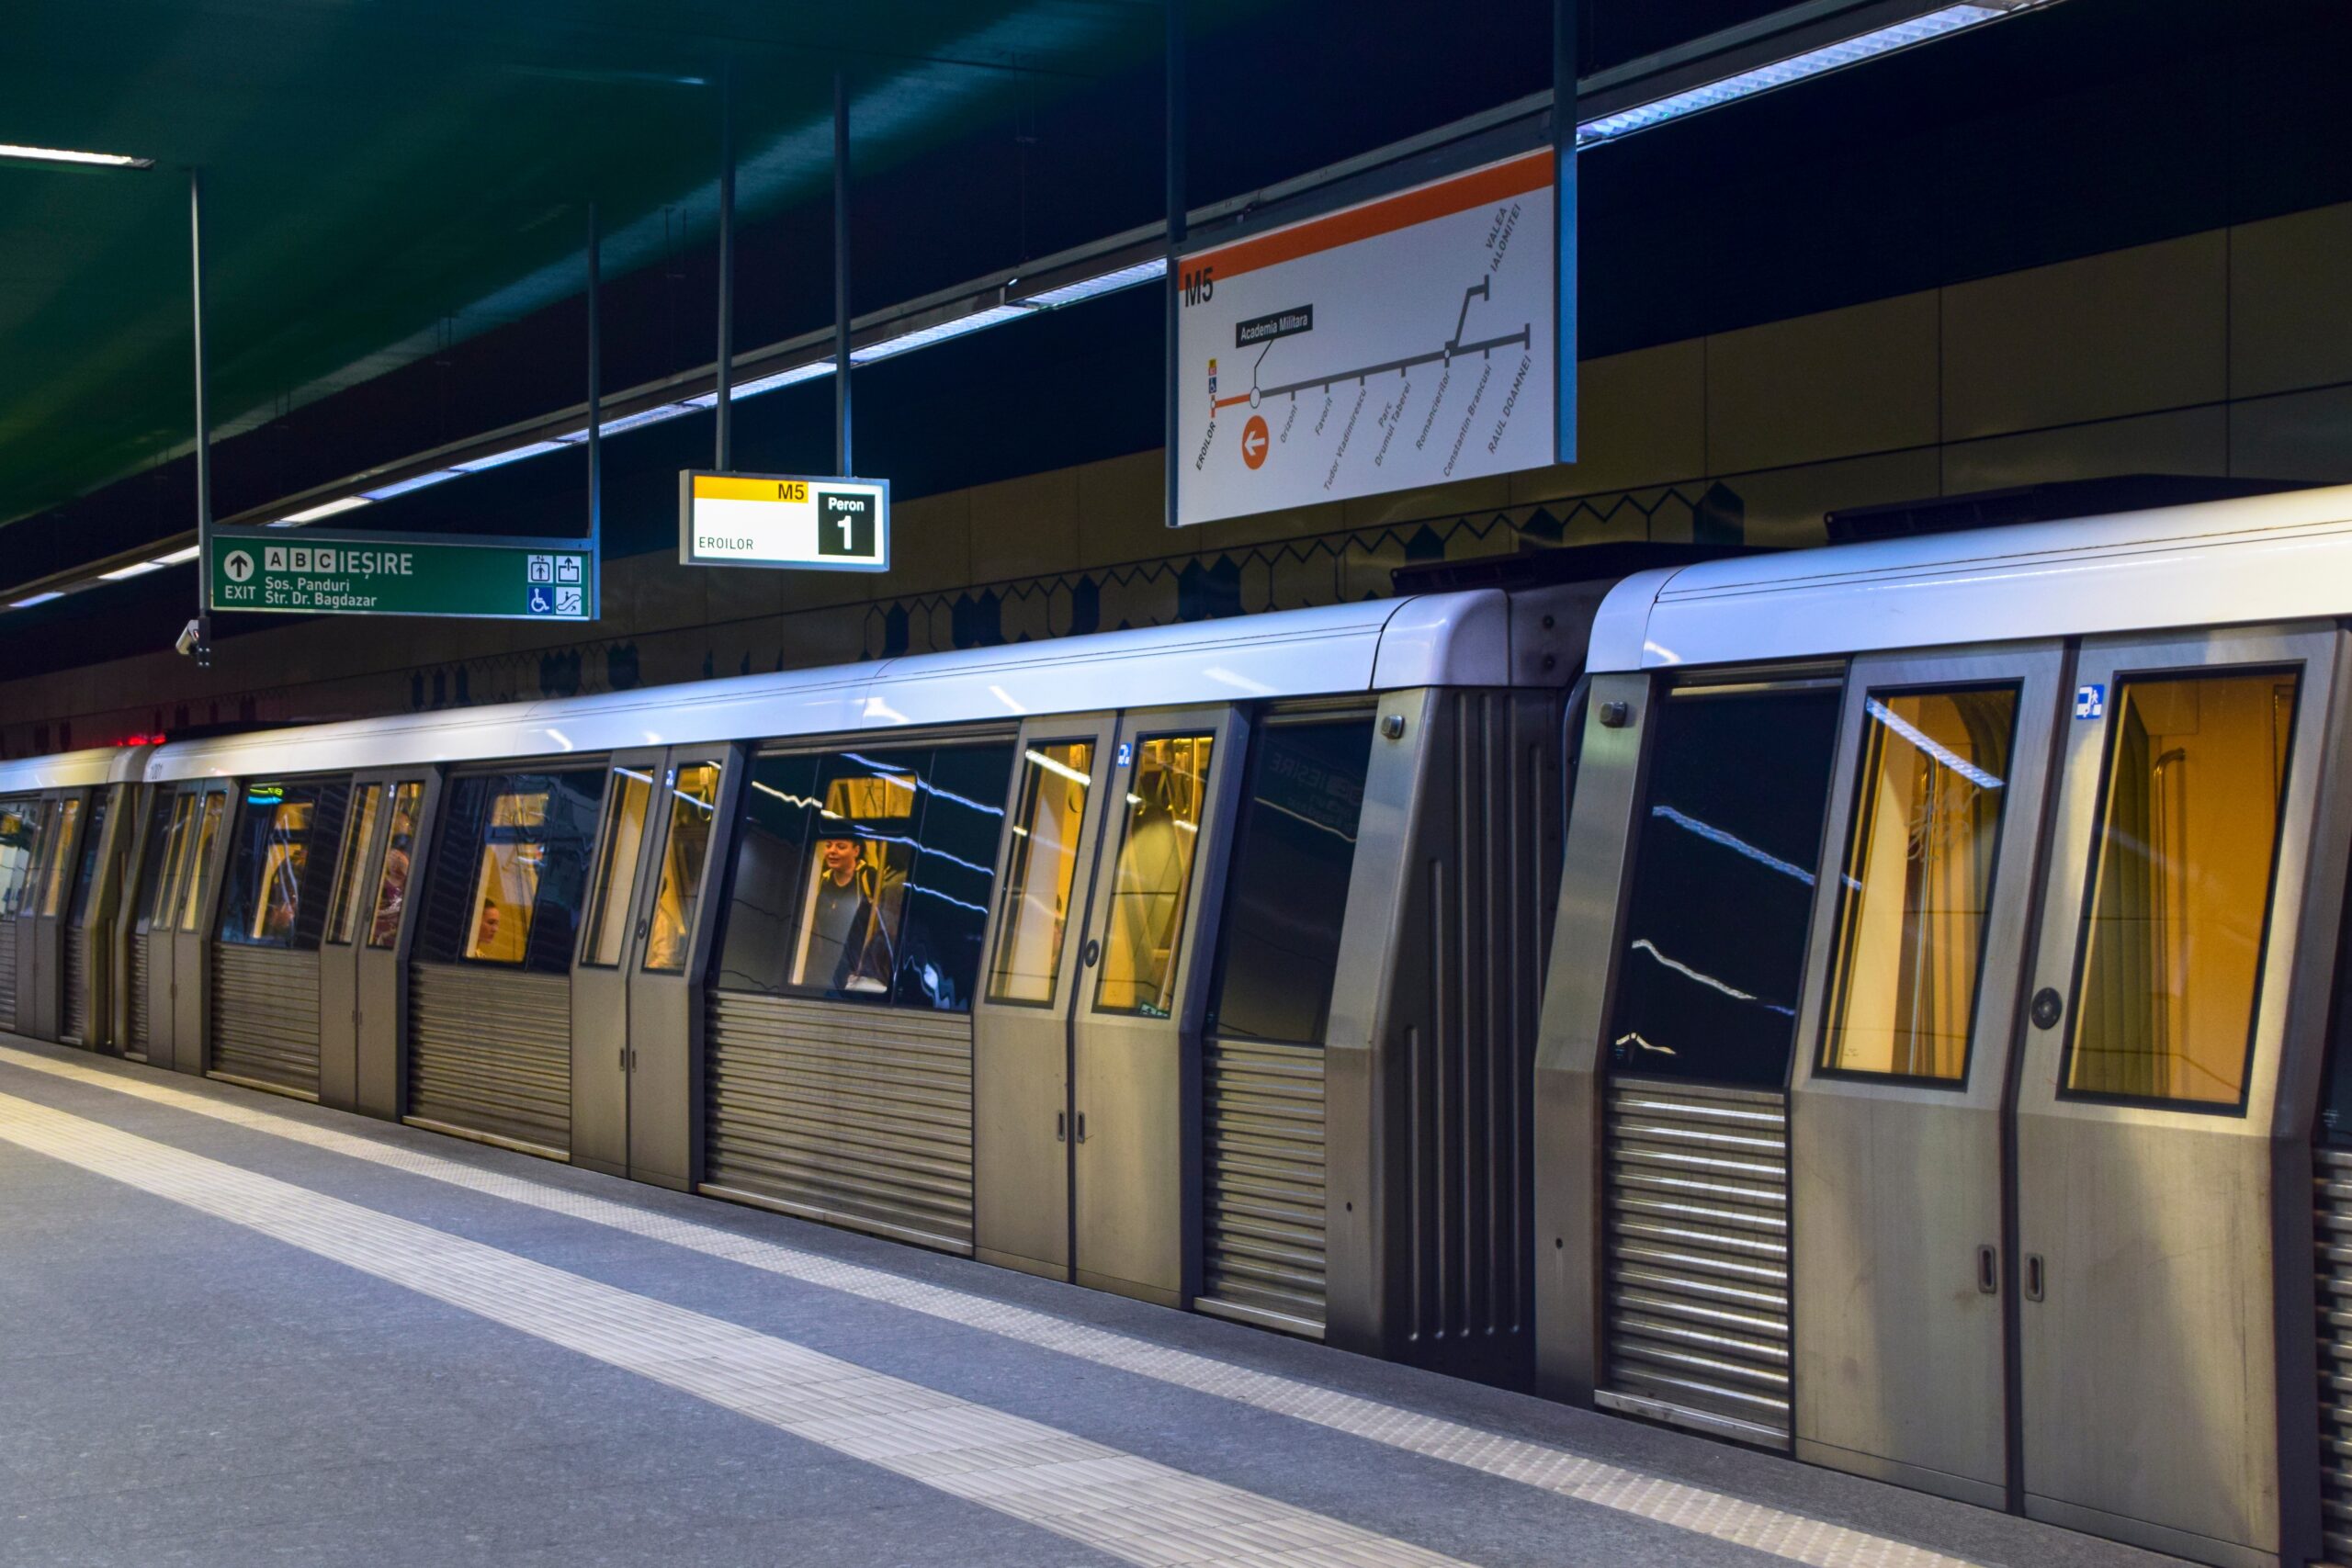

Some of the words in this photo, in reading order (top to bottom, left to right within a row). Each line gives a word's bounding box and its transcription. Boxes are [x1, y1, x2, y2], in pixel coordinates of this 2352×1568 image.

[1486, 207, 1507, 249] VALEA
[1490, 203, 1521, 272] IALOMITEI
[1185, 266, 1214, 308] M5
[1240, 320, 1278, 341] Academia
[1279, 313, 1308, 332] Militara
[1280, 404, 1298, 444] Orizont
[1315, 397, 1333, 436] Favorit
[1374, 423, 1395, 467] Drumul
[1391, 380, 1412, 423] Taberei
[1378, 401, 1393, 428] Parc
[1416, 369, 1451, 451] Romancierilor
[1442, 416, 1472, 478] Constantin
[1467, 363, 1492, 417] Brancusi
[1488, 420, 1507, 456] RAUL
[1502, 355, 1532, 418] DOAMNEI
[1195, 421, 1216, 471] EROILOR
[1324, 458, 1340, 491] Tudor
[1336, 389, 1367, 457] Vladimirescu
[777, 483, 805, 500] M5
[828, 496, 865, 512] Peron
[698, 536, 754, 550] EROILOR
[837, 514, 853, 550] 1
[265, 576, 294, 591] Sos.
[298, 576, 350, 592] Panduri
[339, 550, 413, 580] IEȘIRE
[224, 584, 256, 600] EXIT
[265, 590, 288, 604] Str.
[292, 591, 311, 605] Dr.
[314, 592, 378, 609] Bagdazar
